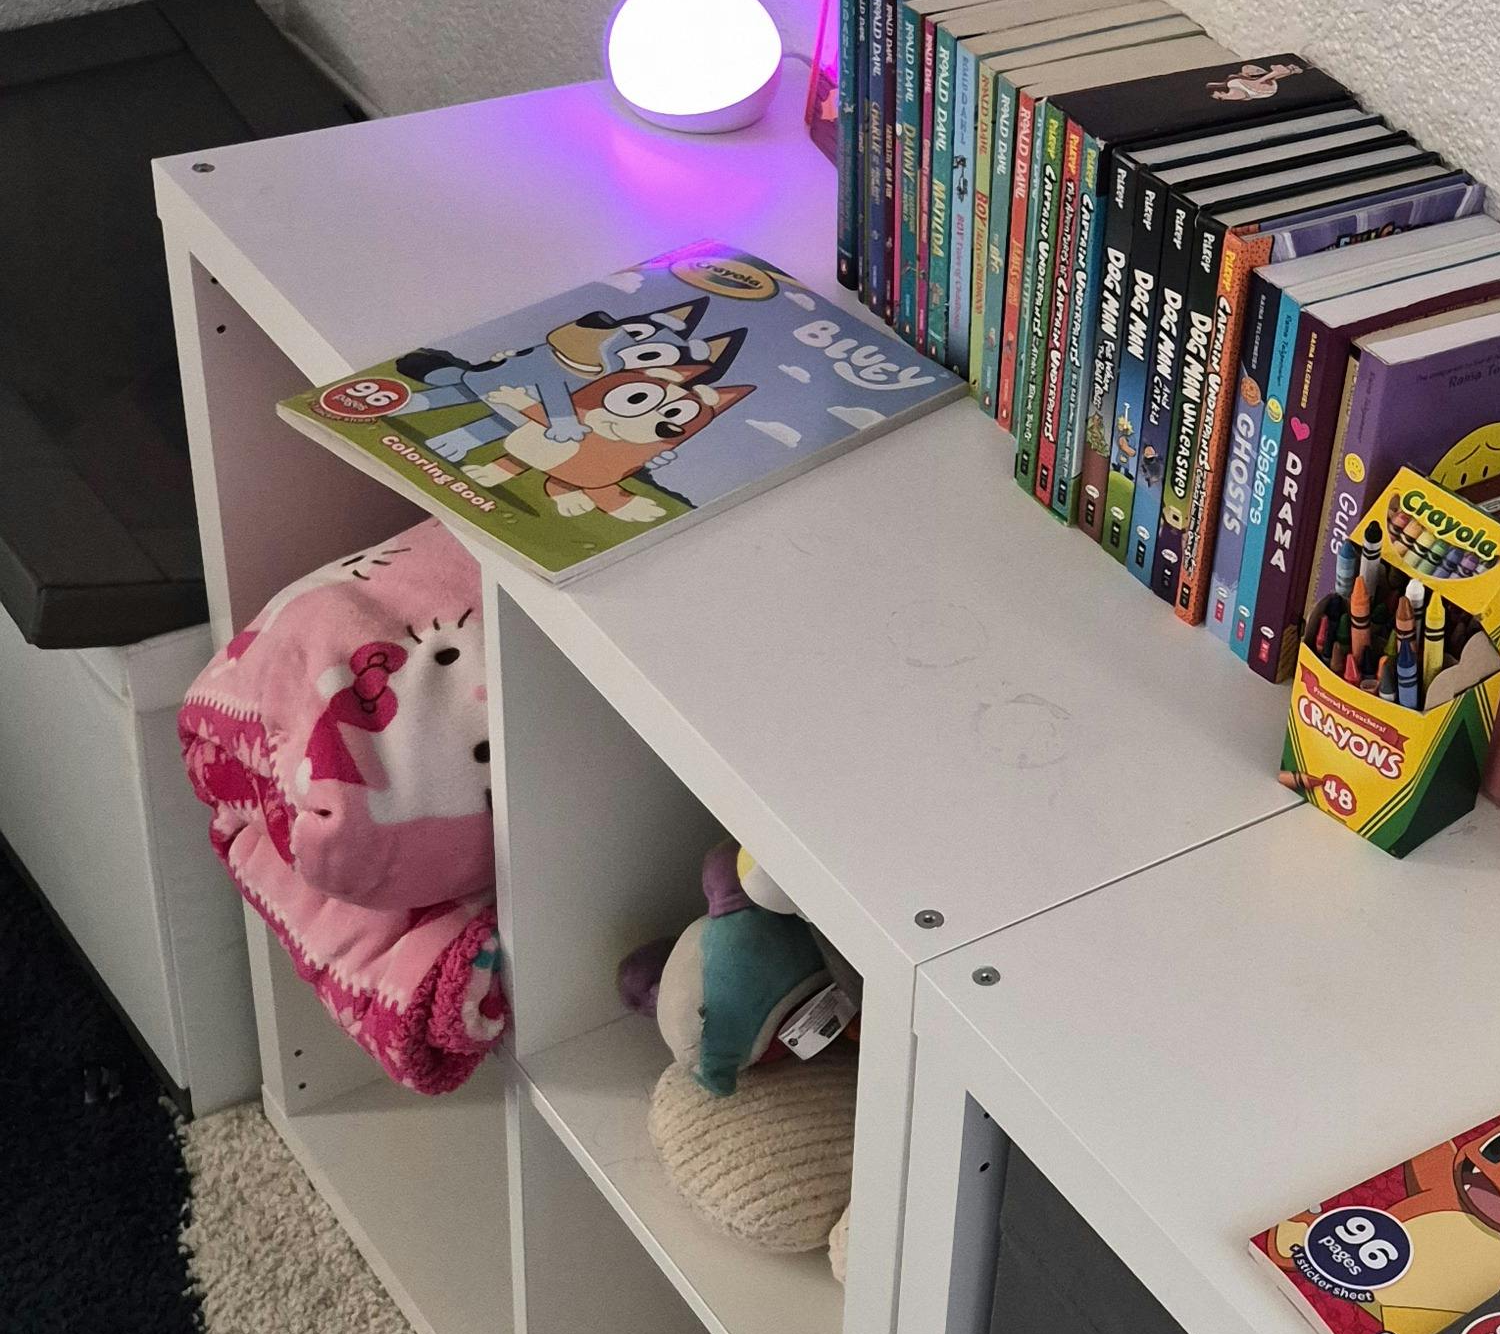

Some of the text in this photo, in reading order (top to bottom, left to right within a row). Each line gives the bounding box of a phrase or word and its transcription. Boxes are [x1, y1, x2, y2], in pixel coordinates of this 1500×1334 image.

[906, 21, 916, 65] ROALD
[905, 68, 915, 104] DAHL
[902, 122, 917, 182] DANNY
[932, 46, 950, 258] ROALD DAHL MATILDA
[997, 92, 1011, 175] ROALD DAHL
[1015, 107, 1031, 200] ROALD DAHL
[975, 190, 989, 228] BOY
[1039, 164, 1057, 240] CAPTAIN
[1077, 193, 1094, 270] CAPTAIN
[1032, 240, 1049, 339] UNDERPANTS
[1103, 246, 1126, 297] DOG
[1130, 268, 1154, 318] DOG
[1069, 269, 1088, 367] UNDERPANTS
[1101, 294, 1121, 339] MAN
[1127, 314, 1148, 361] MAN
[1158, 287, 1182, 338] DOG
[1184, 310, 1212, 362] DOG
[793, 320, 936, 390] BLUEY
[1043, 275, 1069, 443] CAPTAIN UNDERPANTS
[1156, 334, 1176, 381] MAN
[1308, 332, 1318, 361] RAINA
[332, 394, 369, 412] pages
[346, 382, 399, 407] 96
[1181, 356, 1206, 404] MAN
[1197, 295, 1232, 473] CAPTAIN UNDERPANTS
[381, 435, 496, 513] Coloring Book
[1223, 412, 1255, 535] GHOSTS
[1250, 434, 1278, 526] Sisters
[1270, 451, 1303, 573] DRAMA
[1330, 491, 1358, 555] Guts
[1400, 490, 1499, 562] Crayola
[1298, 695, 1404, 779] CRAYONS
[1324, 780, 1353, 810] 48
[1318, 1234, 1362, 1276] pages
[1335, 1217, 1399, 1269] 96
[1298, 1257, 1373, 1303] sticker sheet
